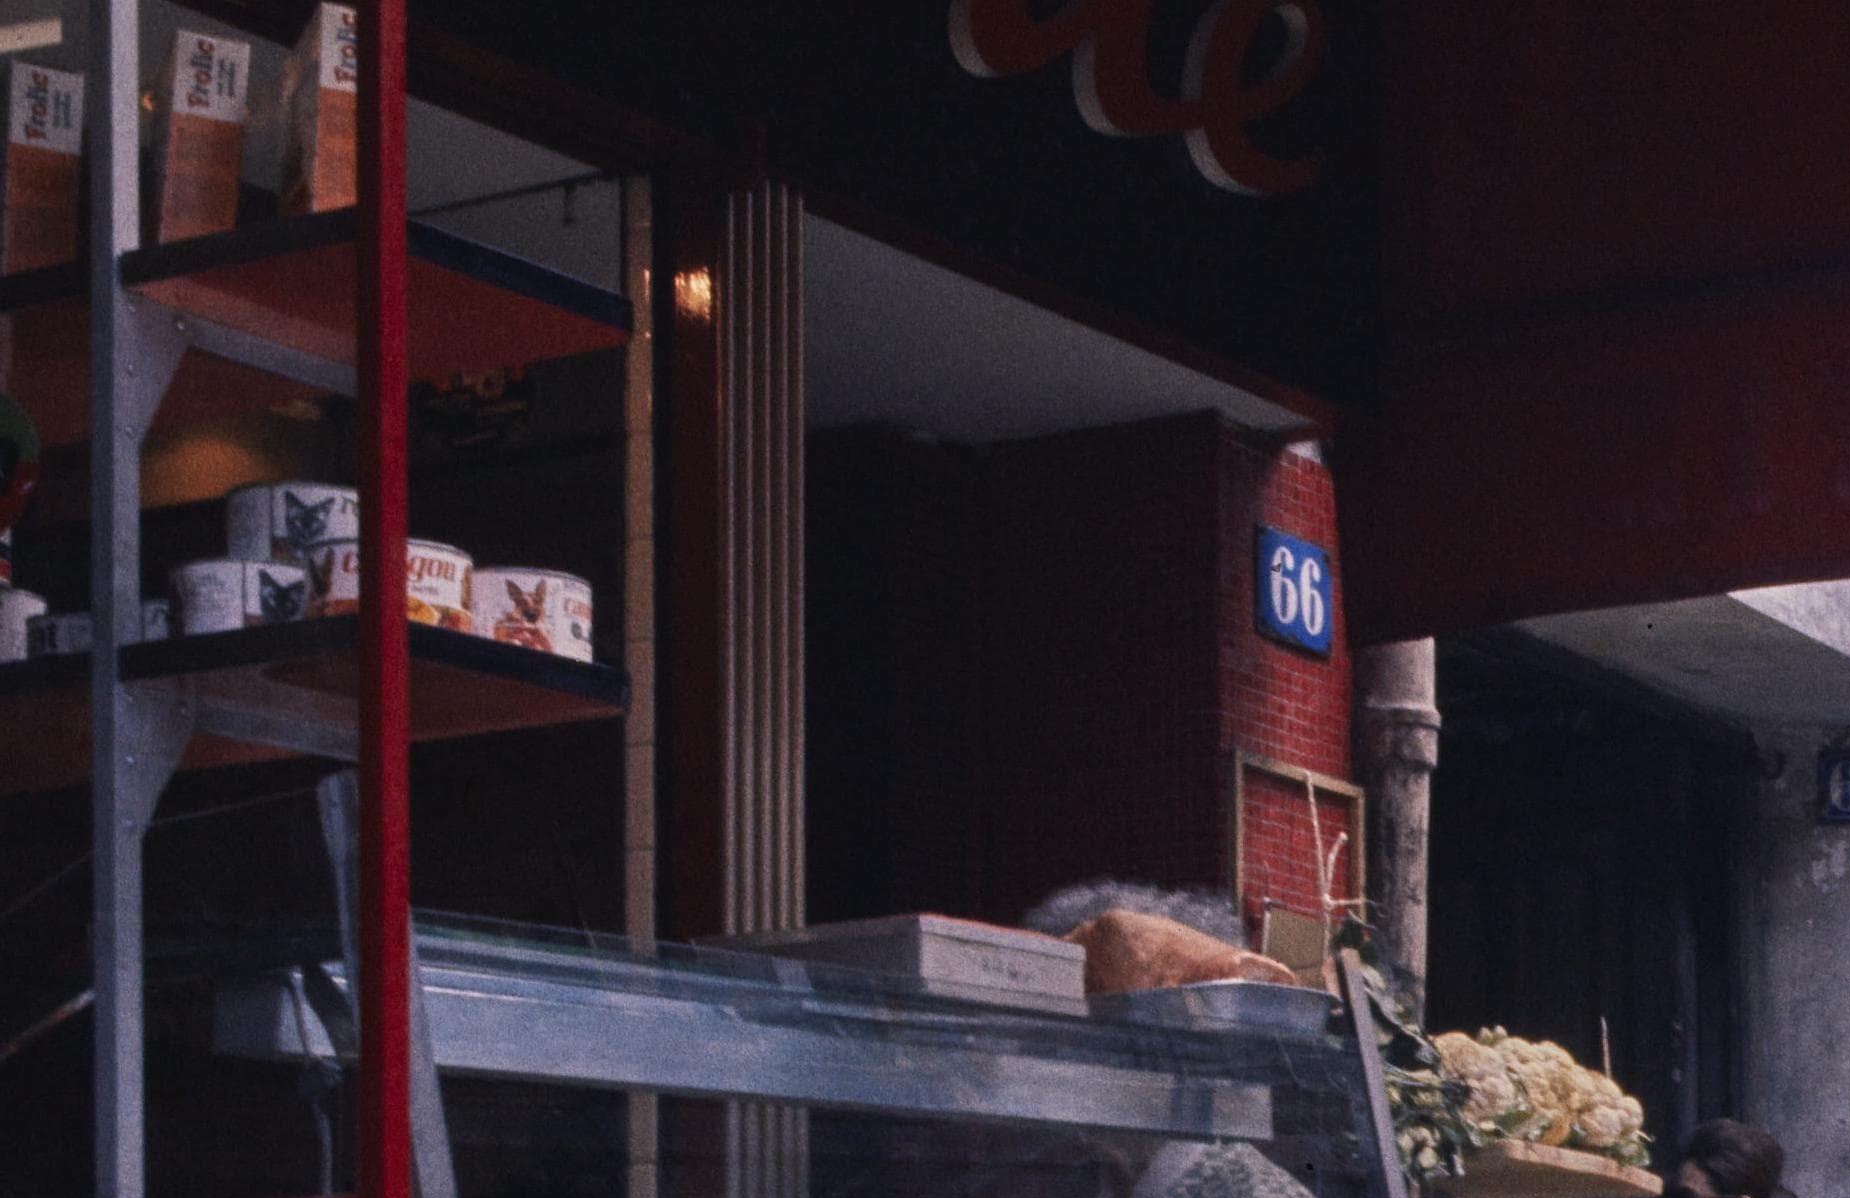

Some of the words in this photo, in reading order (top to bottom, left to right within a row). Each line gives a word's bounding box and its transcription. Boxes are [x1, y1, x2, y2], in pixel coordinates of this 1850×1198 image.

[23, 69, 48, 140] Frolic
[186, 38, 214, 108] Frolic
[1269, 545, 1326, 637] 66
